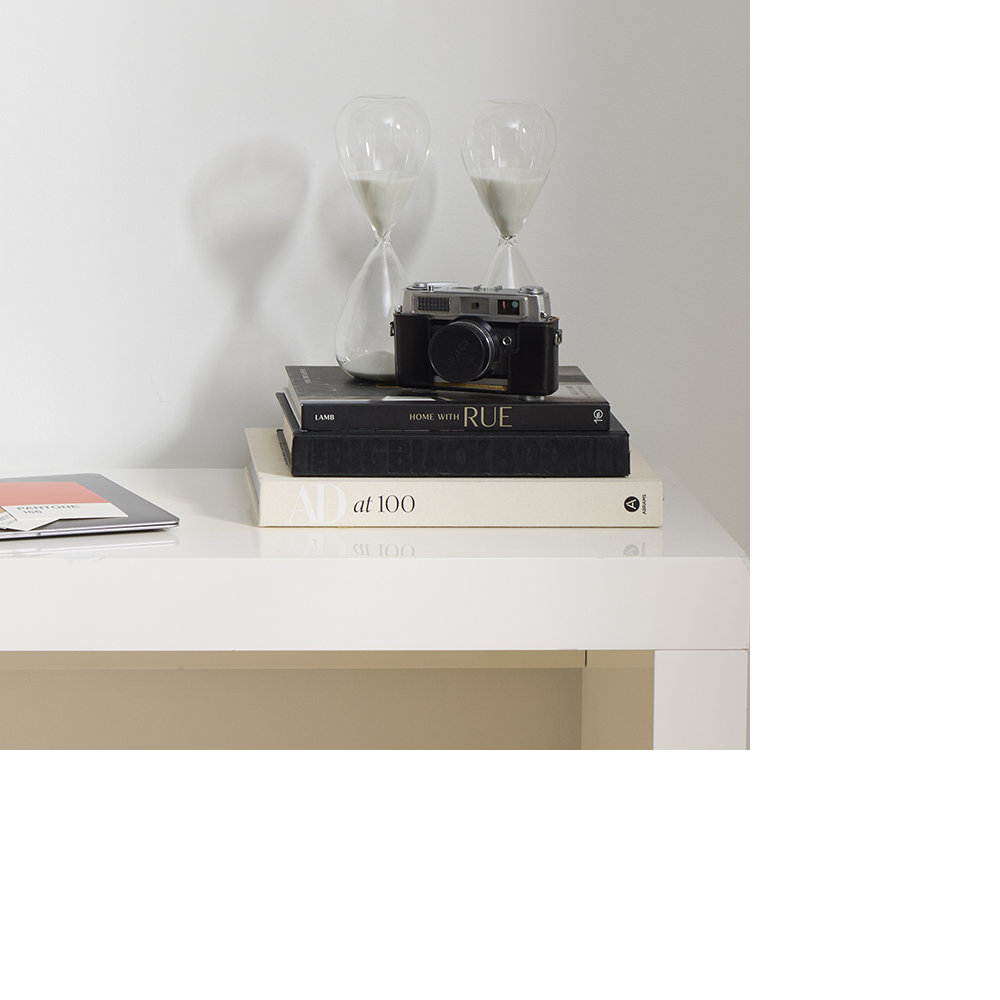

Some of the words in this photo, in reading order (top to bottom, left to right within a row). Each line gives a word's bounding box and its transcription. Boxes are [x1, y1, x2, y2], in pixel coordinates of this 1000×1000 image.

[409, 413, 434, 421] HOME
[437, 413, 460, 421] WITH
[463, 406, 513, 428] RUE
[287, 483, 347, 524] AD
[353, 496, 372, 513] at
[378, 495, 416, 513] 100
